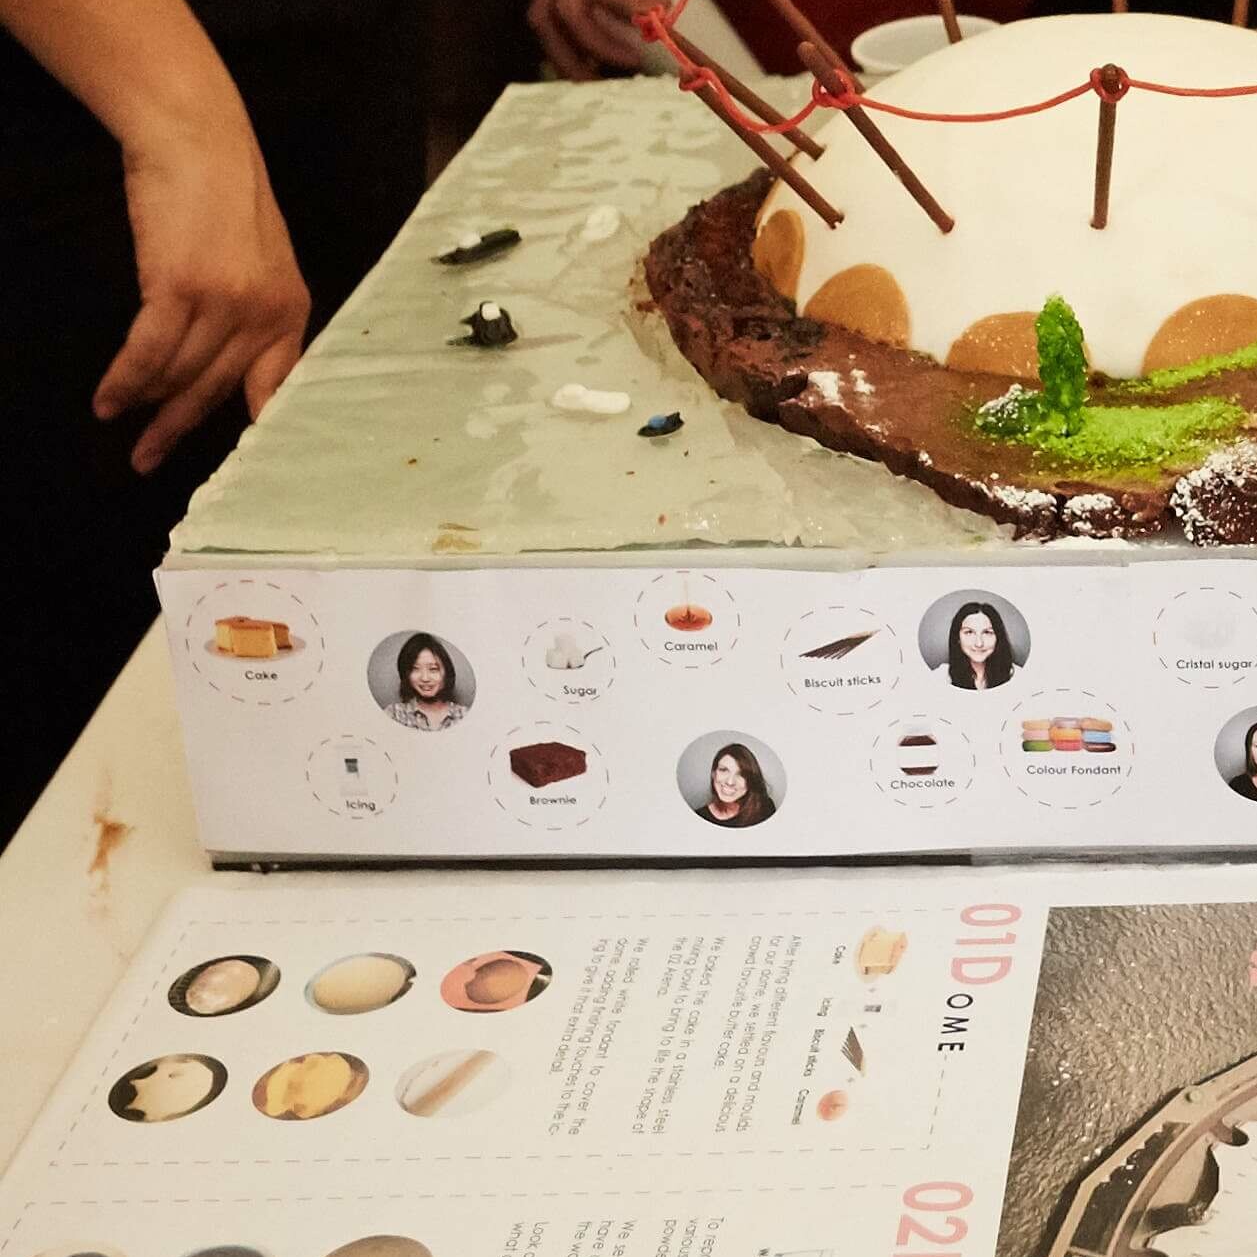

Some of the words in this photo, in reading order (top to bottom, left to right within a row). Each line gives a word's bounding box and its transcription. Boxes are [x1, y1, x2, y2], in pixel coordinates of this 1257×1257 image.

[663, 639, 719, 653] Caramel
[244, 668, 279, 682] Cake
[1175, 657, 1215, 671] Cristal
[1217, 659, 1254, 673] sugar
[804, 677, 845, 689] Biscuit
[847, 673, 882, 687] sticks
[562, 684, 600, 699] Sugar
[1026, 763, 1068, 776] Colour
[1071, 763, 1122, 776] Fondant
[890, 777, 956, 790] Chocolate
[345, 798, 377, 813] Icing
[528, 794, 577, 807] Brownie
[634, 938, 650, 953] We
[710, 936, 727, 951] We
[768, 936, 783, 947] for
[786, 935, 802, 956] After
[764, 951, 777, 965] our
[622, 957, 642, 983] rolled
[775, 959, 795, 984] trying
[611, 989, 630, 1015] white
[693, 990, 709, 1006] the
[765, 987, 788, 1027] different
[816, 997, 833, 1017] Icing
[749, 1004, 762, 1018] we
[684, 1010, 702, 1035] cake
[594, 1020, 621, 1059] fondant
[737, 1022, 759, 1055] settled
[754, 1030, 776, 1067] flavours
[807, 1029, 826, 1053] Biscuit
[590, 1066, 604, 1076] to
[733, 1059, 747, 1072] on
[802, 1055, 818, 1077] sticks
[661, 1065, 686, 1104] stainless
[729, 1076, 741, 1084] a
[747, 1071, 763, 1091] and
[577, 1081, 596, 1111] cover
[715, 1088, 739, 1133] delicious
[736, 1095, 758, 1132] moulds
[791, 1088, 810, 1125] Caramel
[568, 1119, 585, 1135] the
[652, 1109, 671, 1135] steel
[707, 1216, 725, 1230] To
[893, 1181, 974, 1257] 02
[503, 1222, 526, 1251] what
[526, 1221, 551, 1249] Look
[592, 1220, 614, 1250] have
[618, 1220, 638, 1240] We
